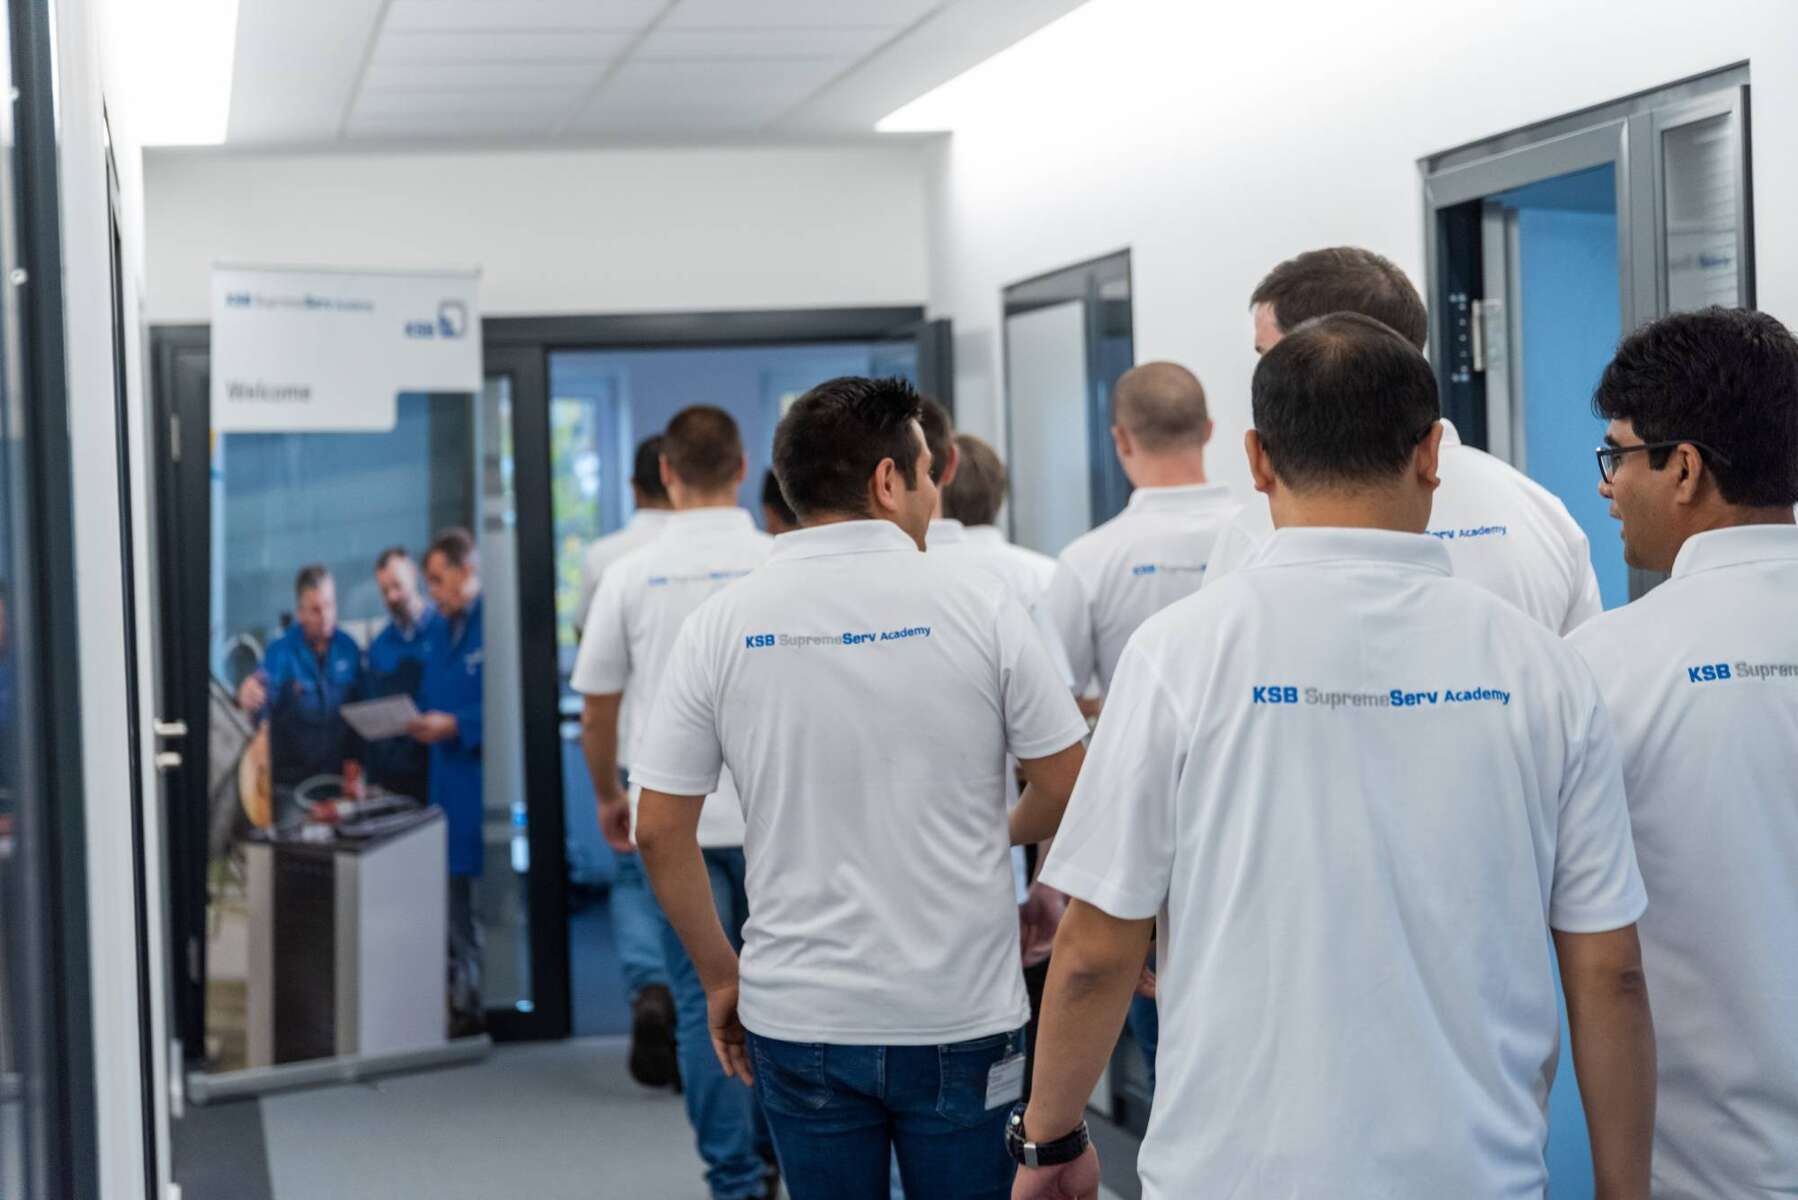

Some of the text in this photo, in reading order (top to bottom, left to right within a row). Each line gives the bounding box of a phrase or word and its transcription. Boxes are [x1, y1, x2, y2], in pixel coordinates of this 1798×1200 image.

[226, 379, 311, 402] Welcome
[1459, 525, 1507, 538] Academy
[745, 626, 931, 649] KSB SupremeServ Academy
[1688, 663, 1732, 683] KSB
[1252, 686, 1511, 710] KSB SupremeServ Academy
